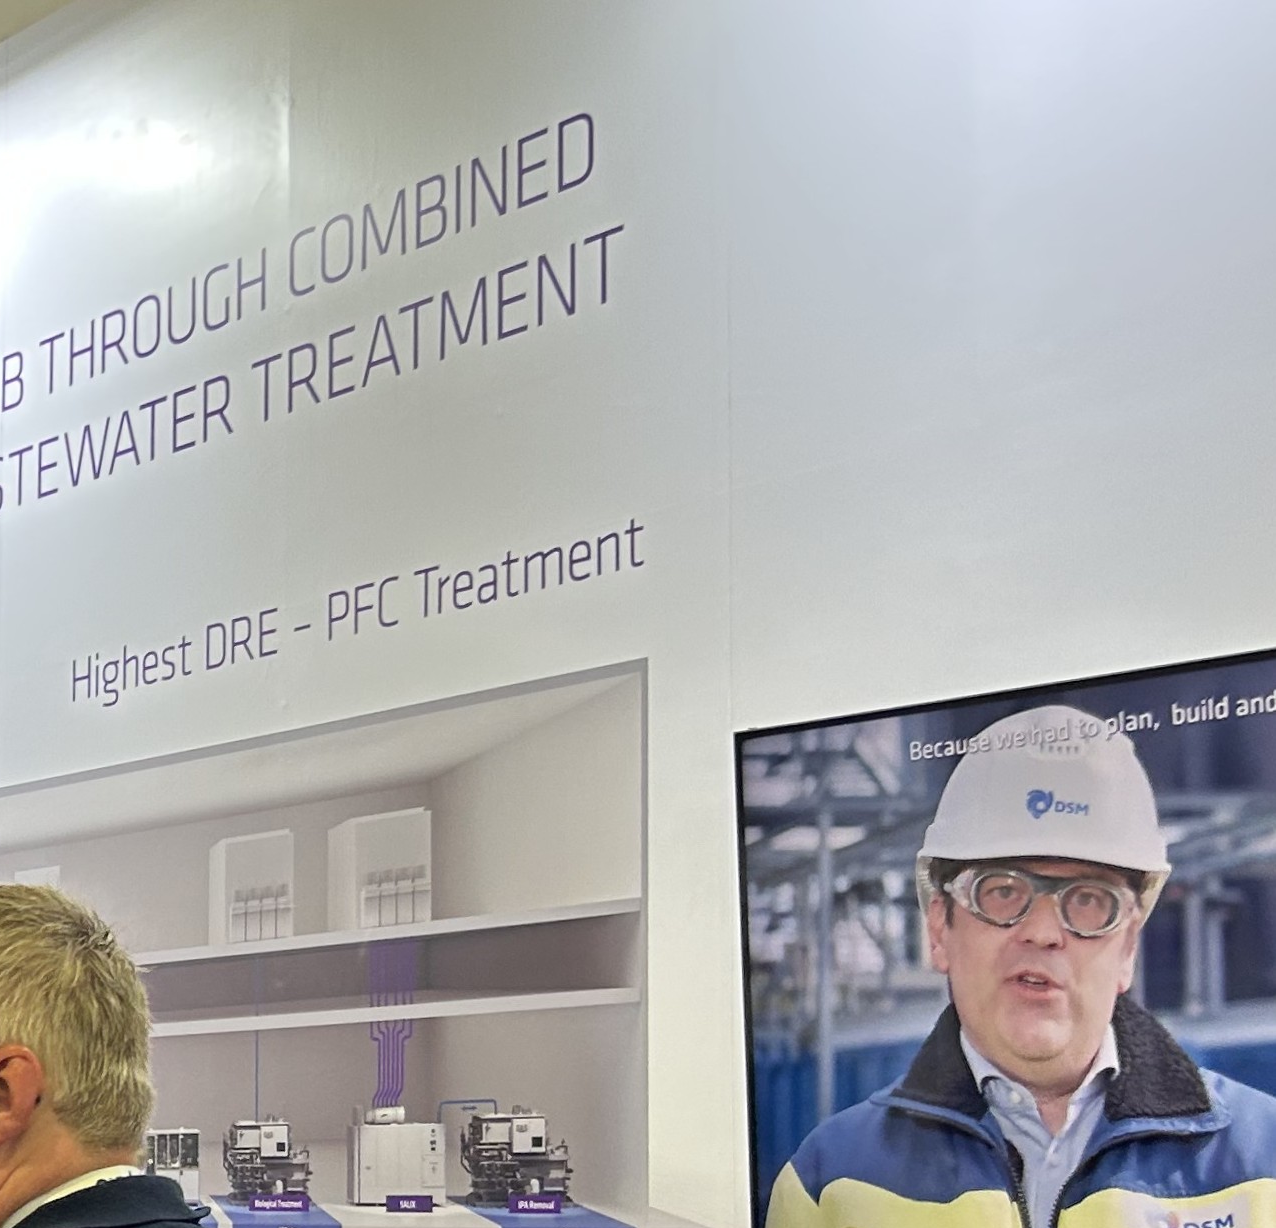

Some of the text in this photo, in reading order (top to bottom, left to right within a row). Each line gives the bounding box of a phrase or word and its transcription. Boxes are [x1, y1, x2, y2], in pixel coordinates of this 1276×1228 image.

[39, 247, 267, 395] THROUGH
[288, 112, 596, 298] COMBINED
[250, 224, 625, 422] TREATMENT
[71, 635, 193, 707] Highest
[204, 607, 280, 672] DRE
[327, 575, 400, 642] PFC
[414, 517, 645, 618] Treatment
[909, 689, 1276, 761] Because we had to plan, build and
[1054, 801, 1089, 816] DSM
